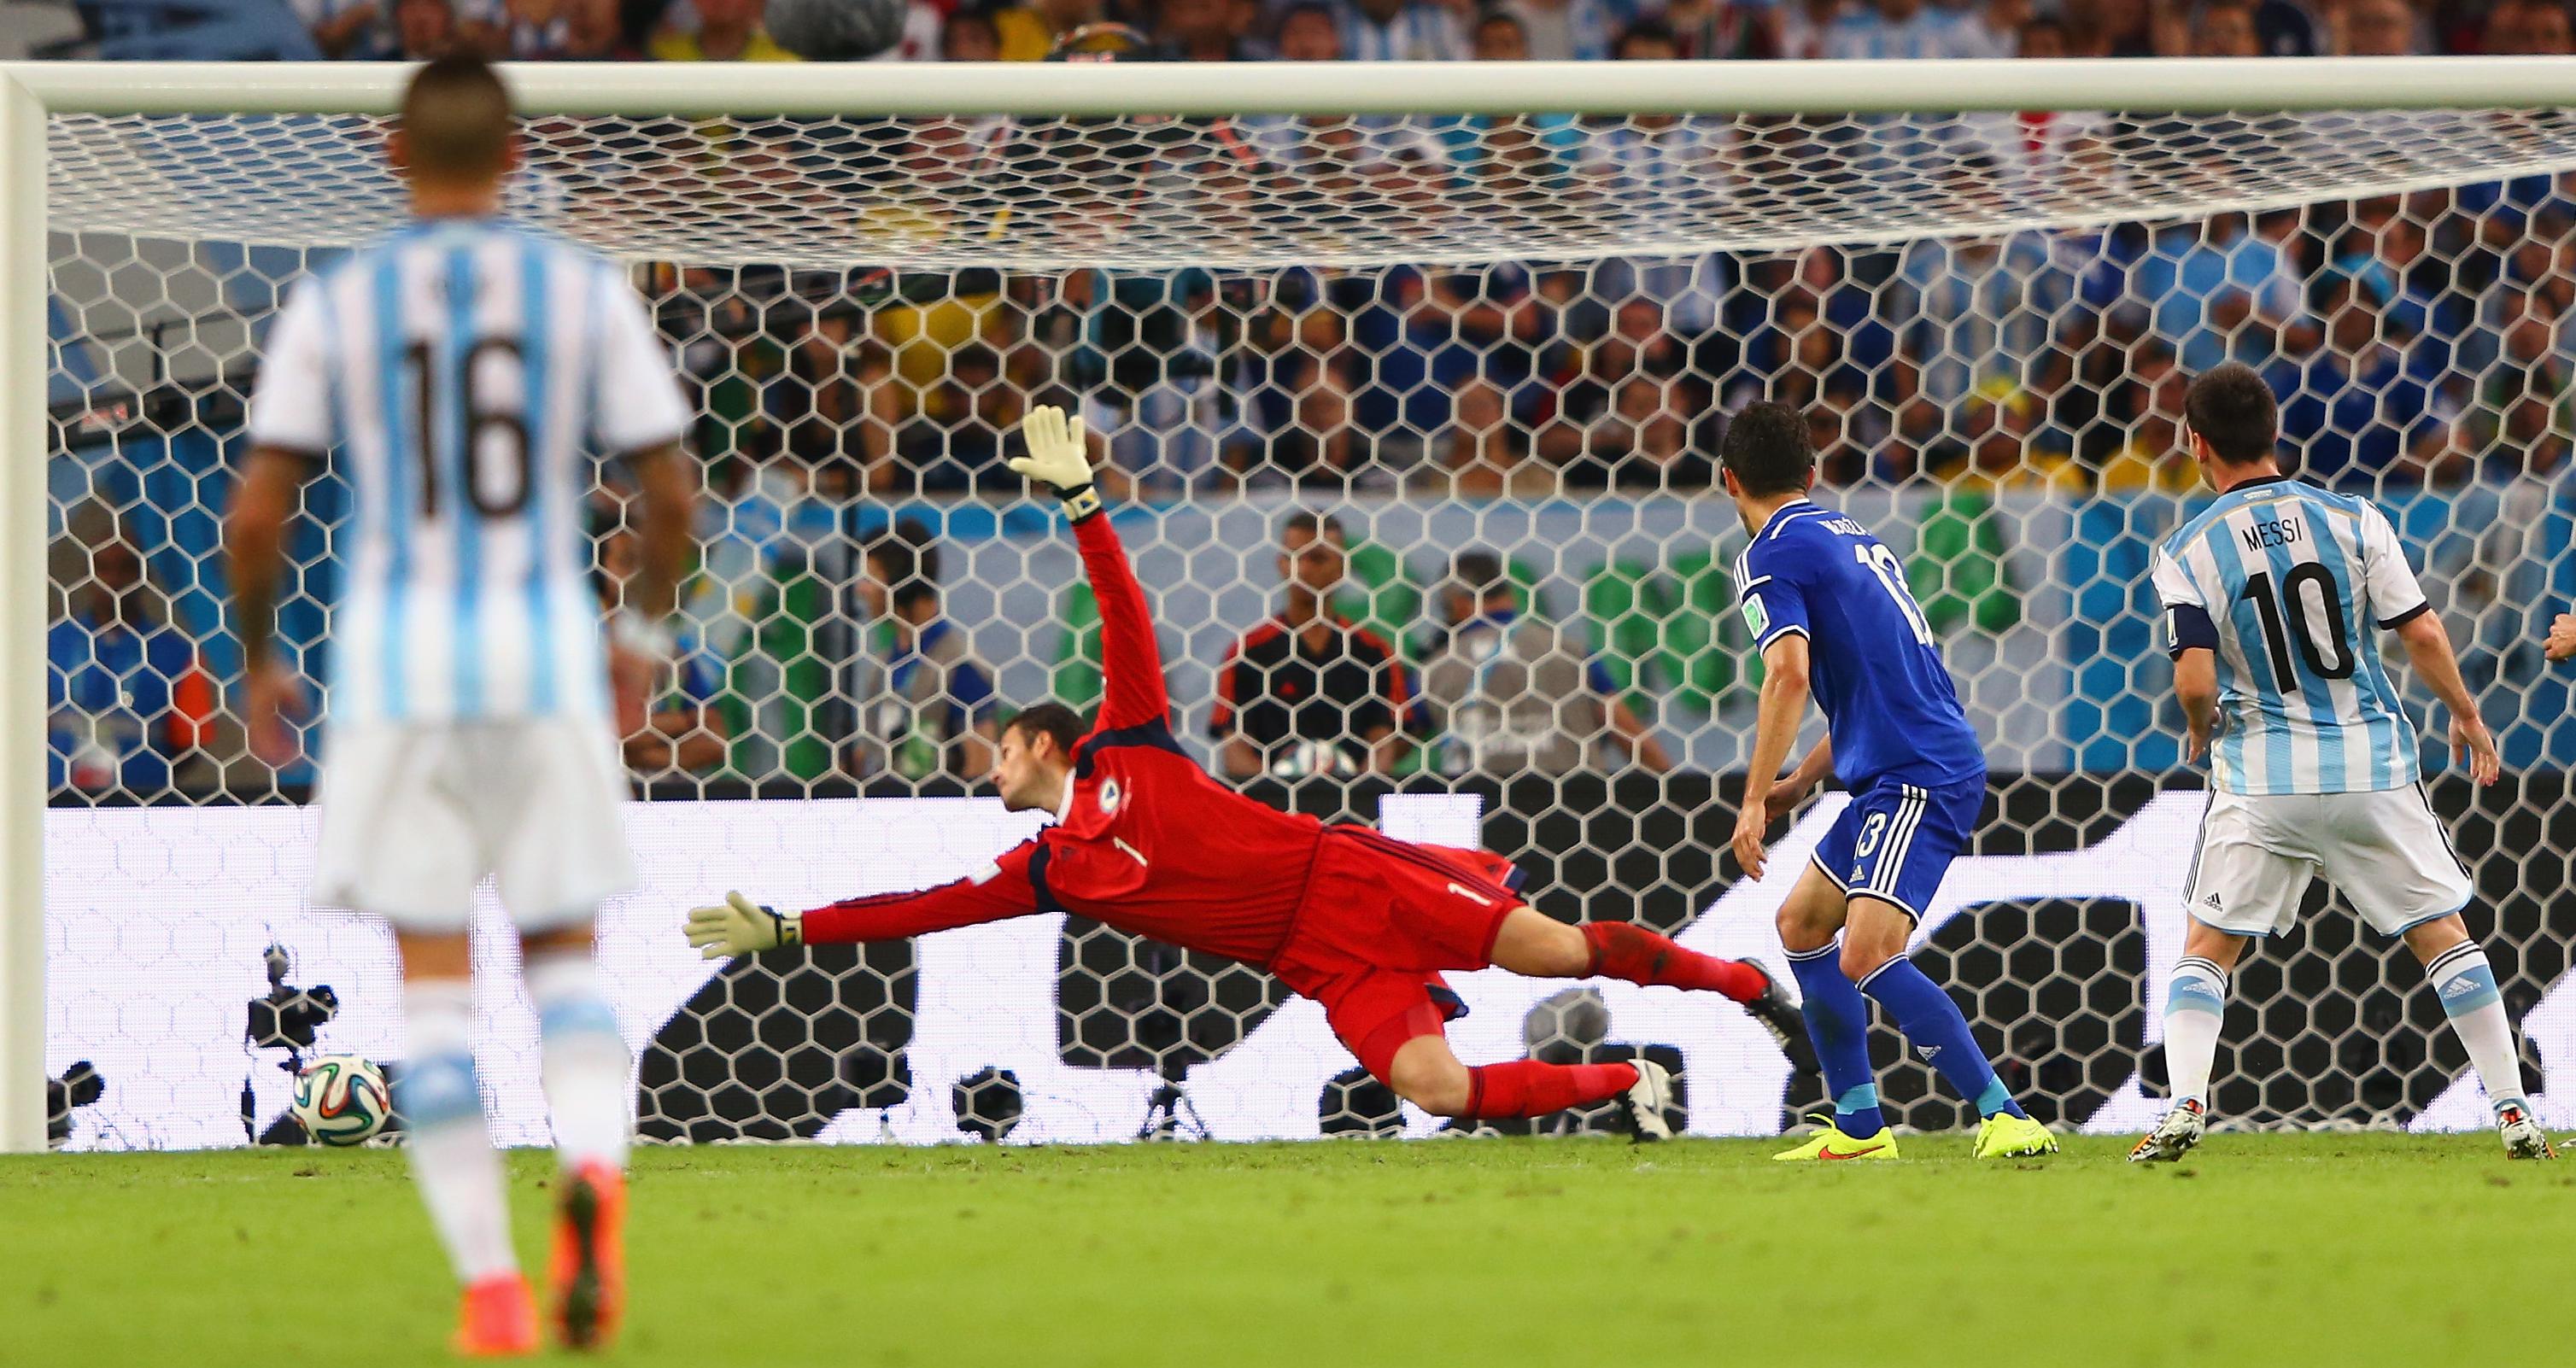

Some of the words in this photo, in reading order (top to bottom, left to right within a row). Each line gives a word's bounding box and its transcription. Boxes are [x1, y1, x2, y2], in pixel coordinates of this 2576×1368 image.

[401, 337, 533, 519] 16
[2241, 517, 2303, 552] MESSI
[1854, 543, 1935, 648] 13
[2240, 561, 2356, 695] 10
[1113, 835, 1149, 868] 1
[1447, 882, 1493, 907] 1
